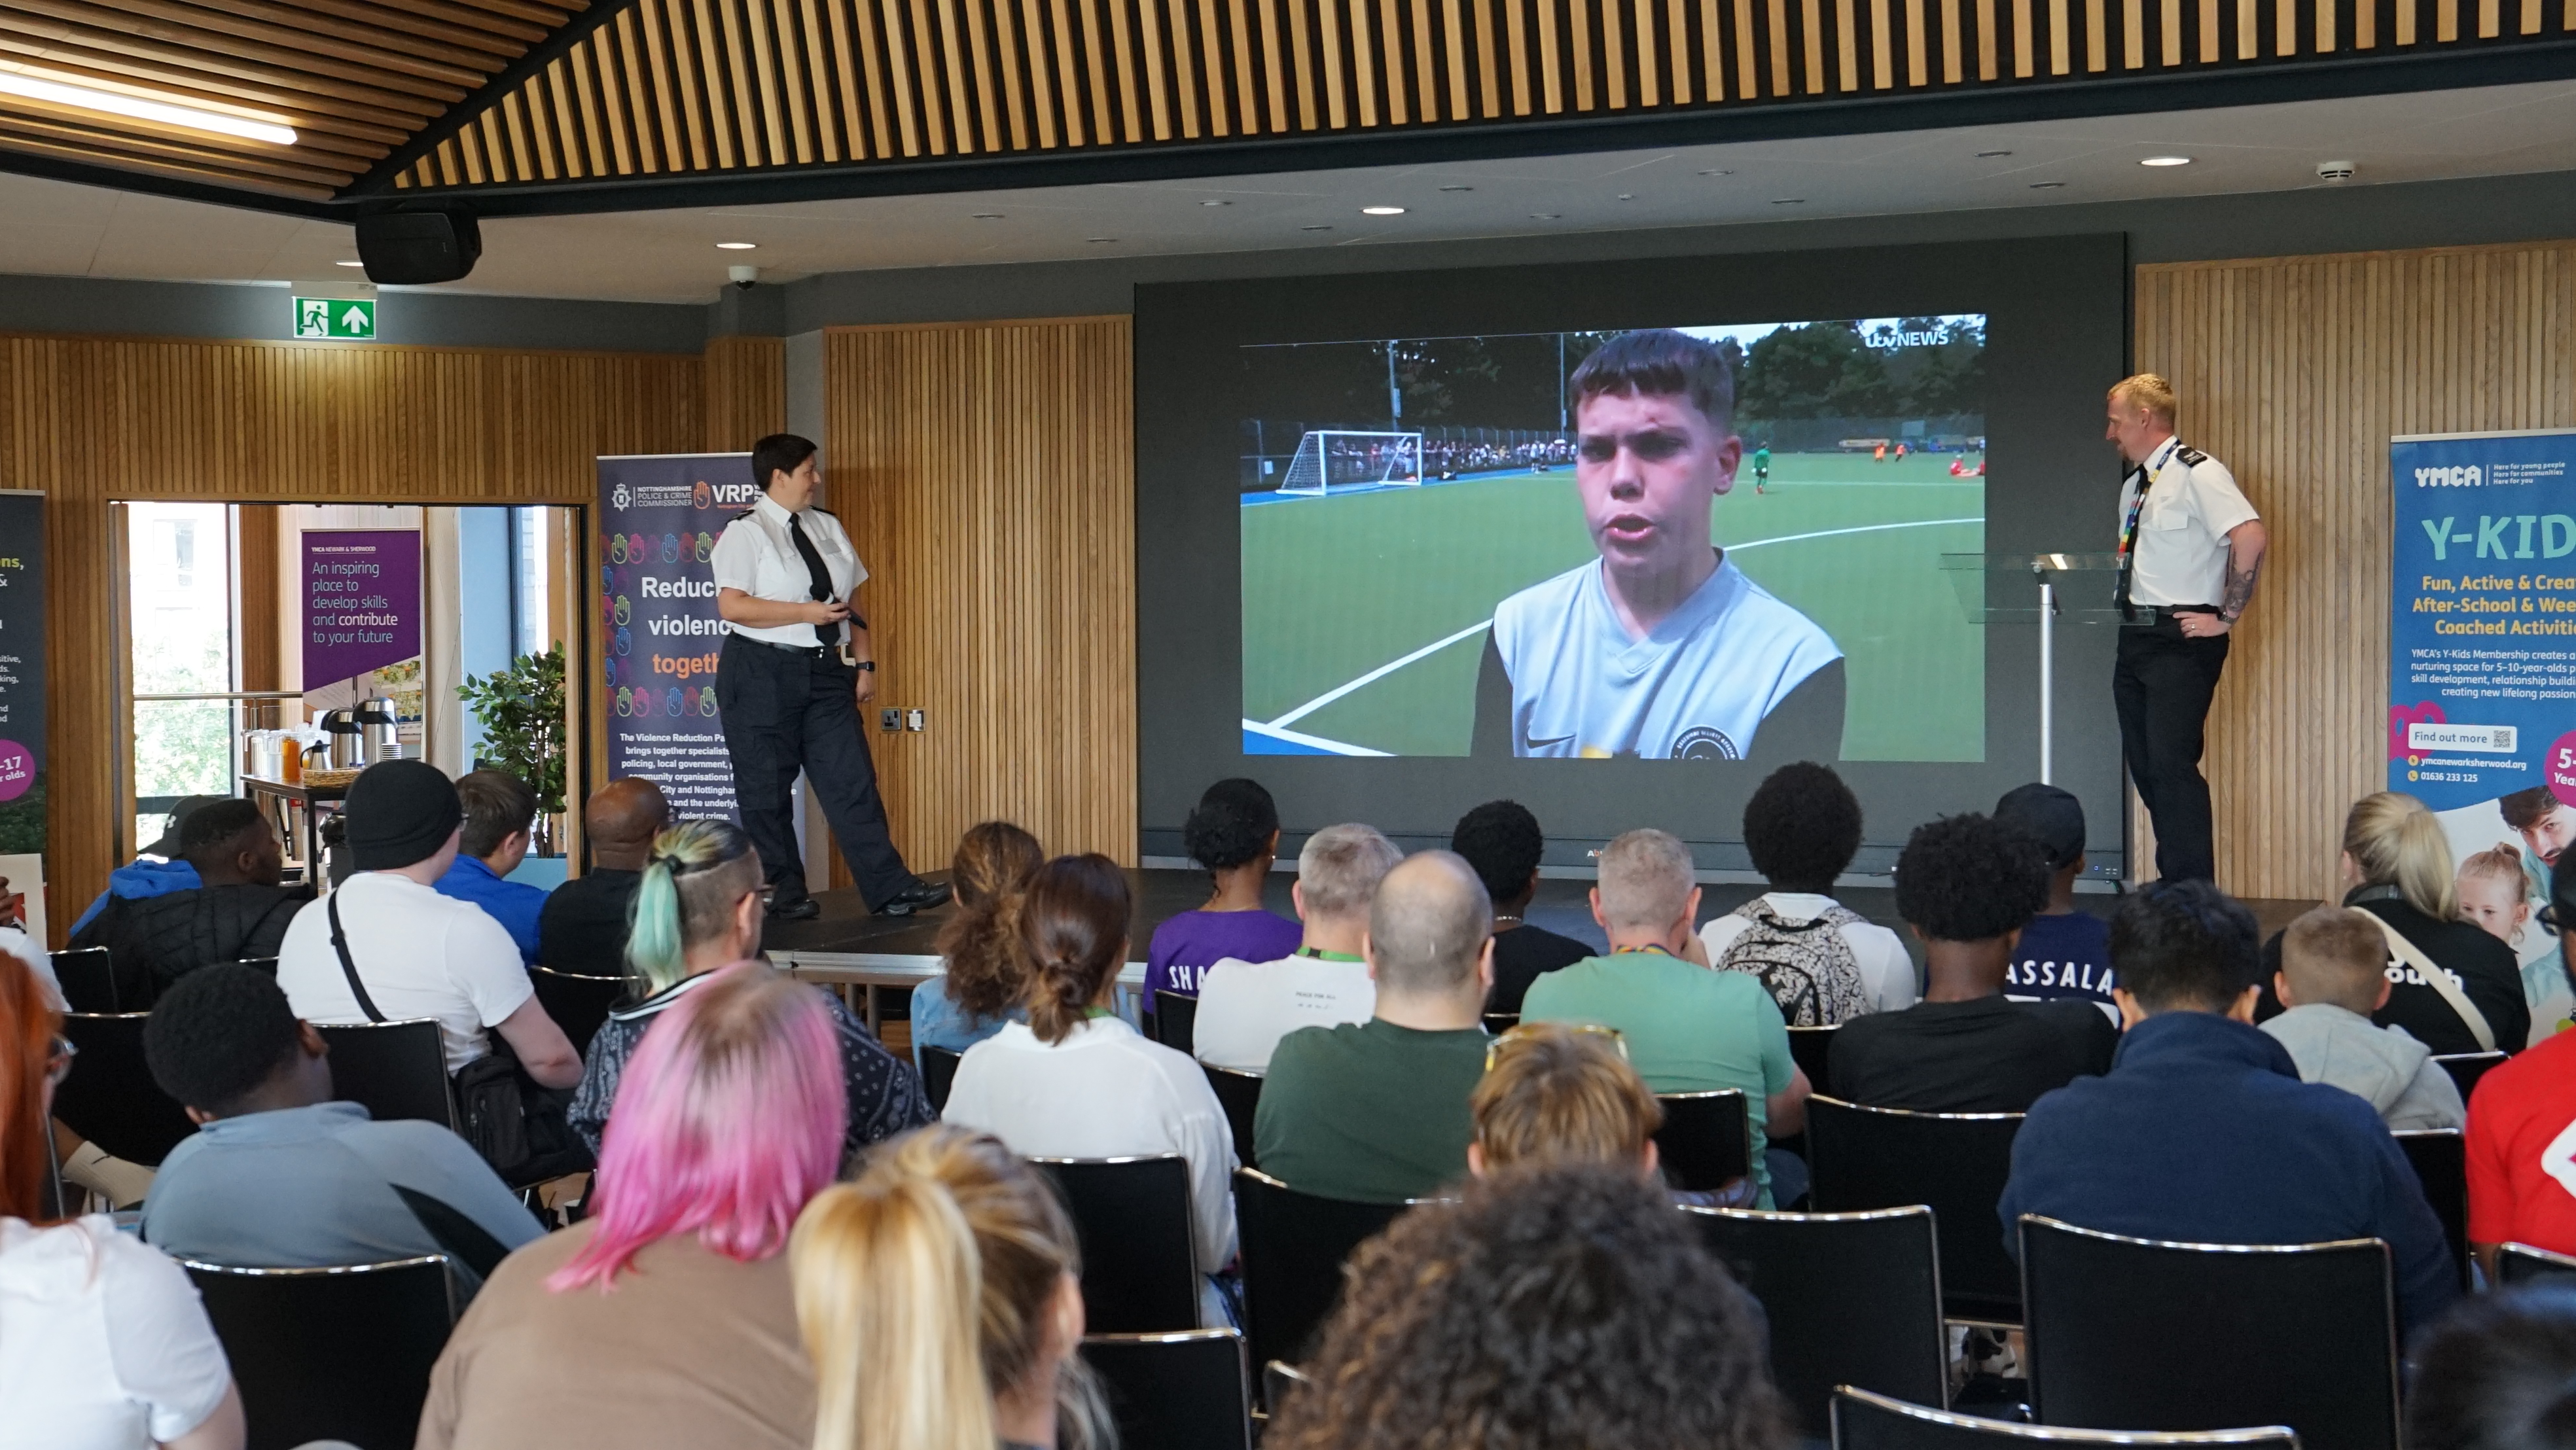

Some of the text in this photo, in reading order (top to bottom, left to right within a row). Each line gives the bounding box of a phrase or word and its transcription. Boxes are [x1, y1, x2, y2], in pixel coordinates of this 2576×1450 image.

[1865, 330, 1949, 347] itv NEWS
[2543, 461, 2566, 470] people
[2414, 465, 2481, 487] YMCA
[711, 484, 754, 503] VRP
[2421, 514, 2576, 561] Y-KID
[0, 557, 24, 571] ns,
[312, 561, 380, 578] An inspiring
[312, 578, 359, 595] place to
[641, 576, 718, 598] Reduc
[2422, 575, 2576, 593] Fun, Active & Crea
[312, 595, 388, 612] develop skills
[2412, 597, 2576, 613] After-School & Wee
[312, 612, 398, 626] and contribute
[648, 614, 732, 636] violenc
[2435, 619, 2576, 635] Coached Activitie
[313, 629, 393, 646] to your future
[2411, 649, 2441, 658] YMCA's
[2443, 649, 2471, 659] Y-Kids
[2473, 650, 2530, 662] Membership
[2531, 651, 2567, 660] creates
[653, 652, 719, 679] togeth
[2410, 662, 2450, 673] nurturing
[2452, 663, 2479, 673] space
[2482, 662, 2494, 671] for
[2411, 674, 2576, 688] skill development, relationship buildi
[2442, 688, 2576, 701] creating new lifelong passion
[620, 733, 634, 741] The
[673, 733, 713, 742] Reduction
[2414, 732, 2437, 741] Find
[2439, 734, 2457, 743] out
[625, 747, 730, 756] brings together specialists
[2557, 748, 2576, 769] 5-
[621, 760, 656, 769] policing,
[657, 760, 677, 768] local
[678, 760, 728, 769] government,
[2421, 756, 2527, 771] ymcanewarksherwood.org
[5, 770, 26, 781] olds
[675, 773, 728, 783] organisations
[2421, 772, 2478, 782] 01636 233 125
[2554, 772, 2576, 787] Yea
[660, 786, 676, 796] City
[694, 787, 735, 796] Nottingha
[704, 800, 739, 809] underlyi
